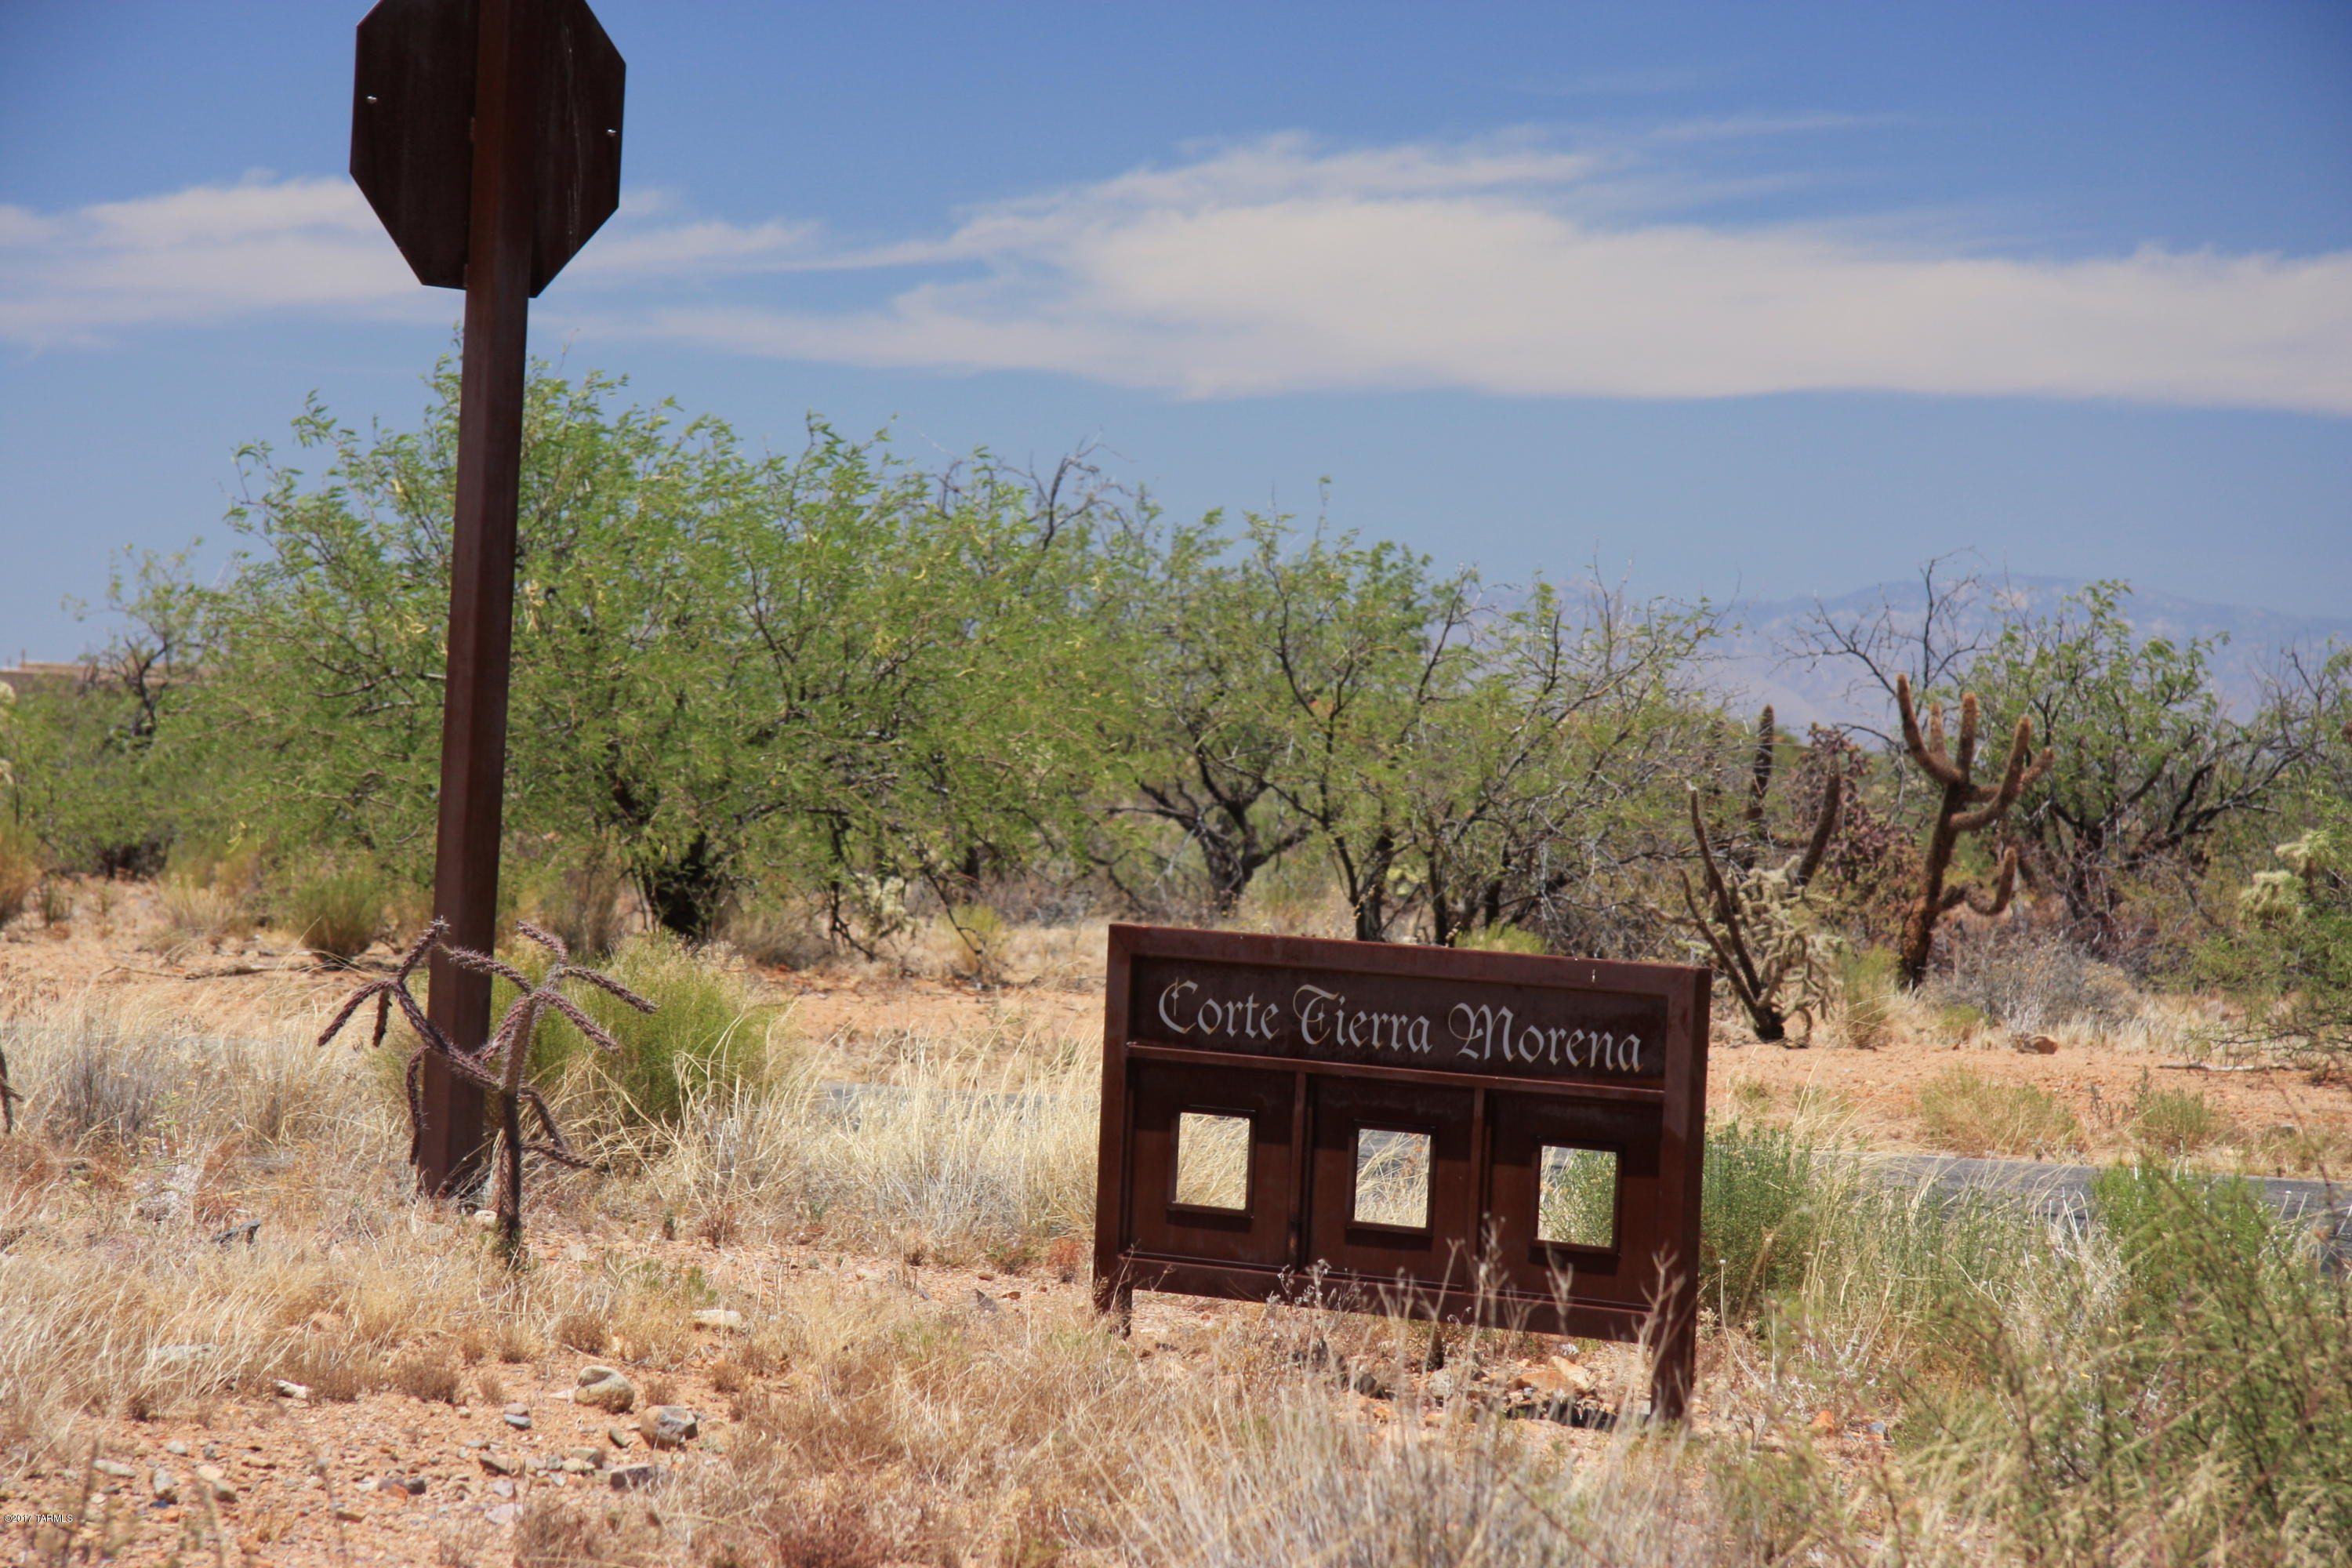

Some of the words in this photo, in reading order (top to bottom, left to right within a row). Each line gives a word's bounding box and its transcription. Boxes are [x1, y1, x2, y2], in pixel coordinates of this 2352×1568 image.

[1158, 977, 1279, 1040] Corte
[1293, 985, 1433, 1054] Tierra
[1448, 1002, 1644, 1072] Morena
